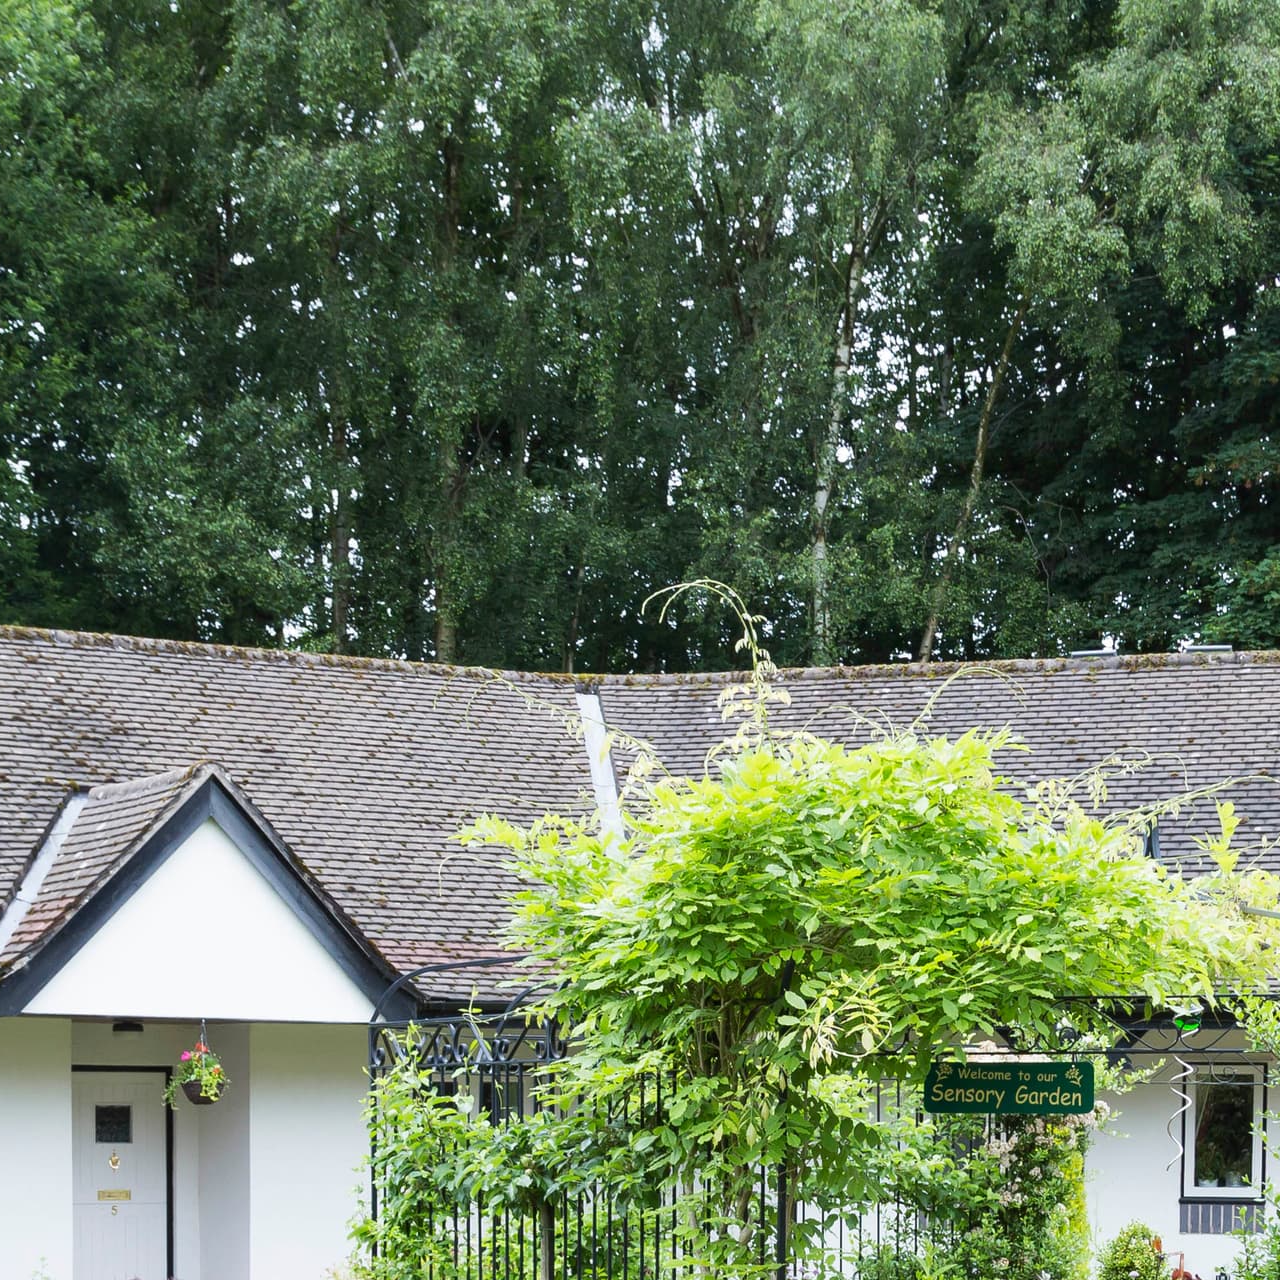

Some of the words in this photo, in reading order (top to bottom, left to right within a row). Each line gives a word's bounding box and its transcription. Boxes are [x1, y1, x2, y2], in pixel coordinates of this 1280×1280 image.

[958, 1068, 1011, 1080] Welcome
[1018, 1070, 1031, 1081] to
[1037, 1072, 1057, 1082] our
[930, 1084, 1005, 1109] Sensory
[1015, 1085, 1082, 1106] Garden
[111, 1205, 118, 1216] 5
